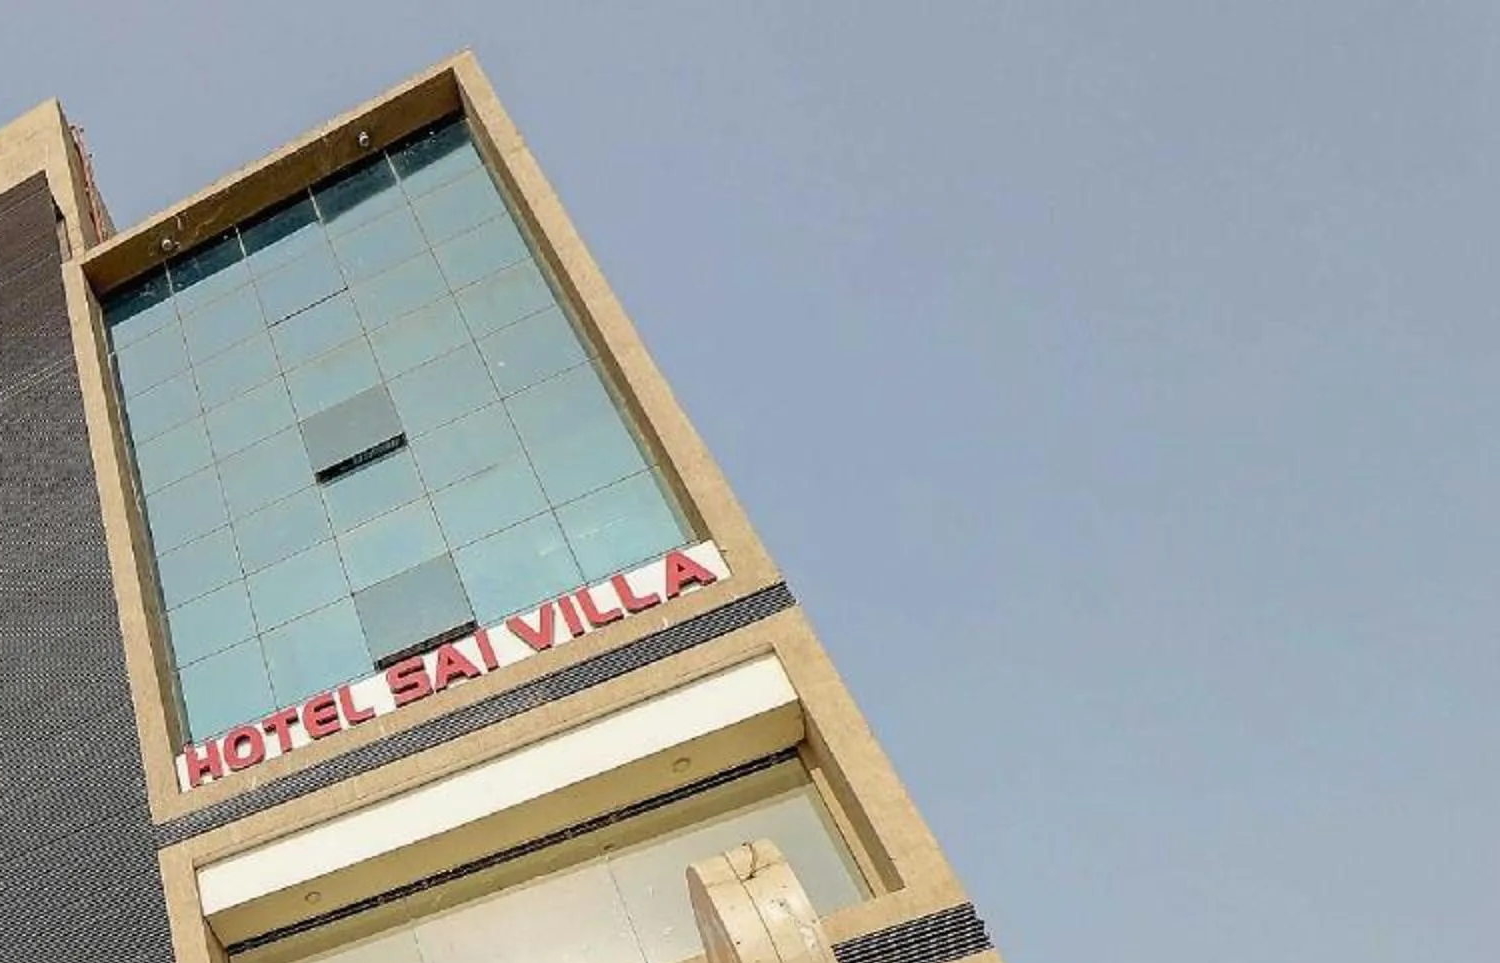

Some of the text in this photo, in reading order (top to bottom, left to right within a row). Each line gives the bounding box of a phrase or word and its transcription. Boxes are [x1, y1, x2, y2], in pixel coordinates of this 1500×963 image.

[185, 548, 717, 788] HOTEL SAI VILLA
